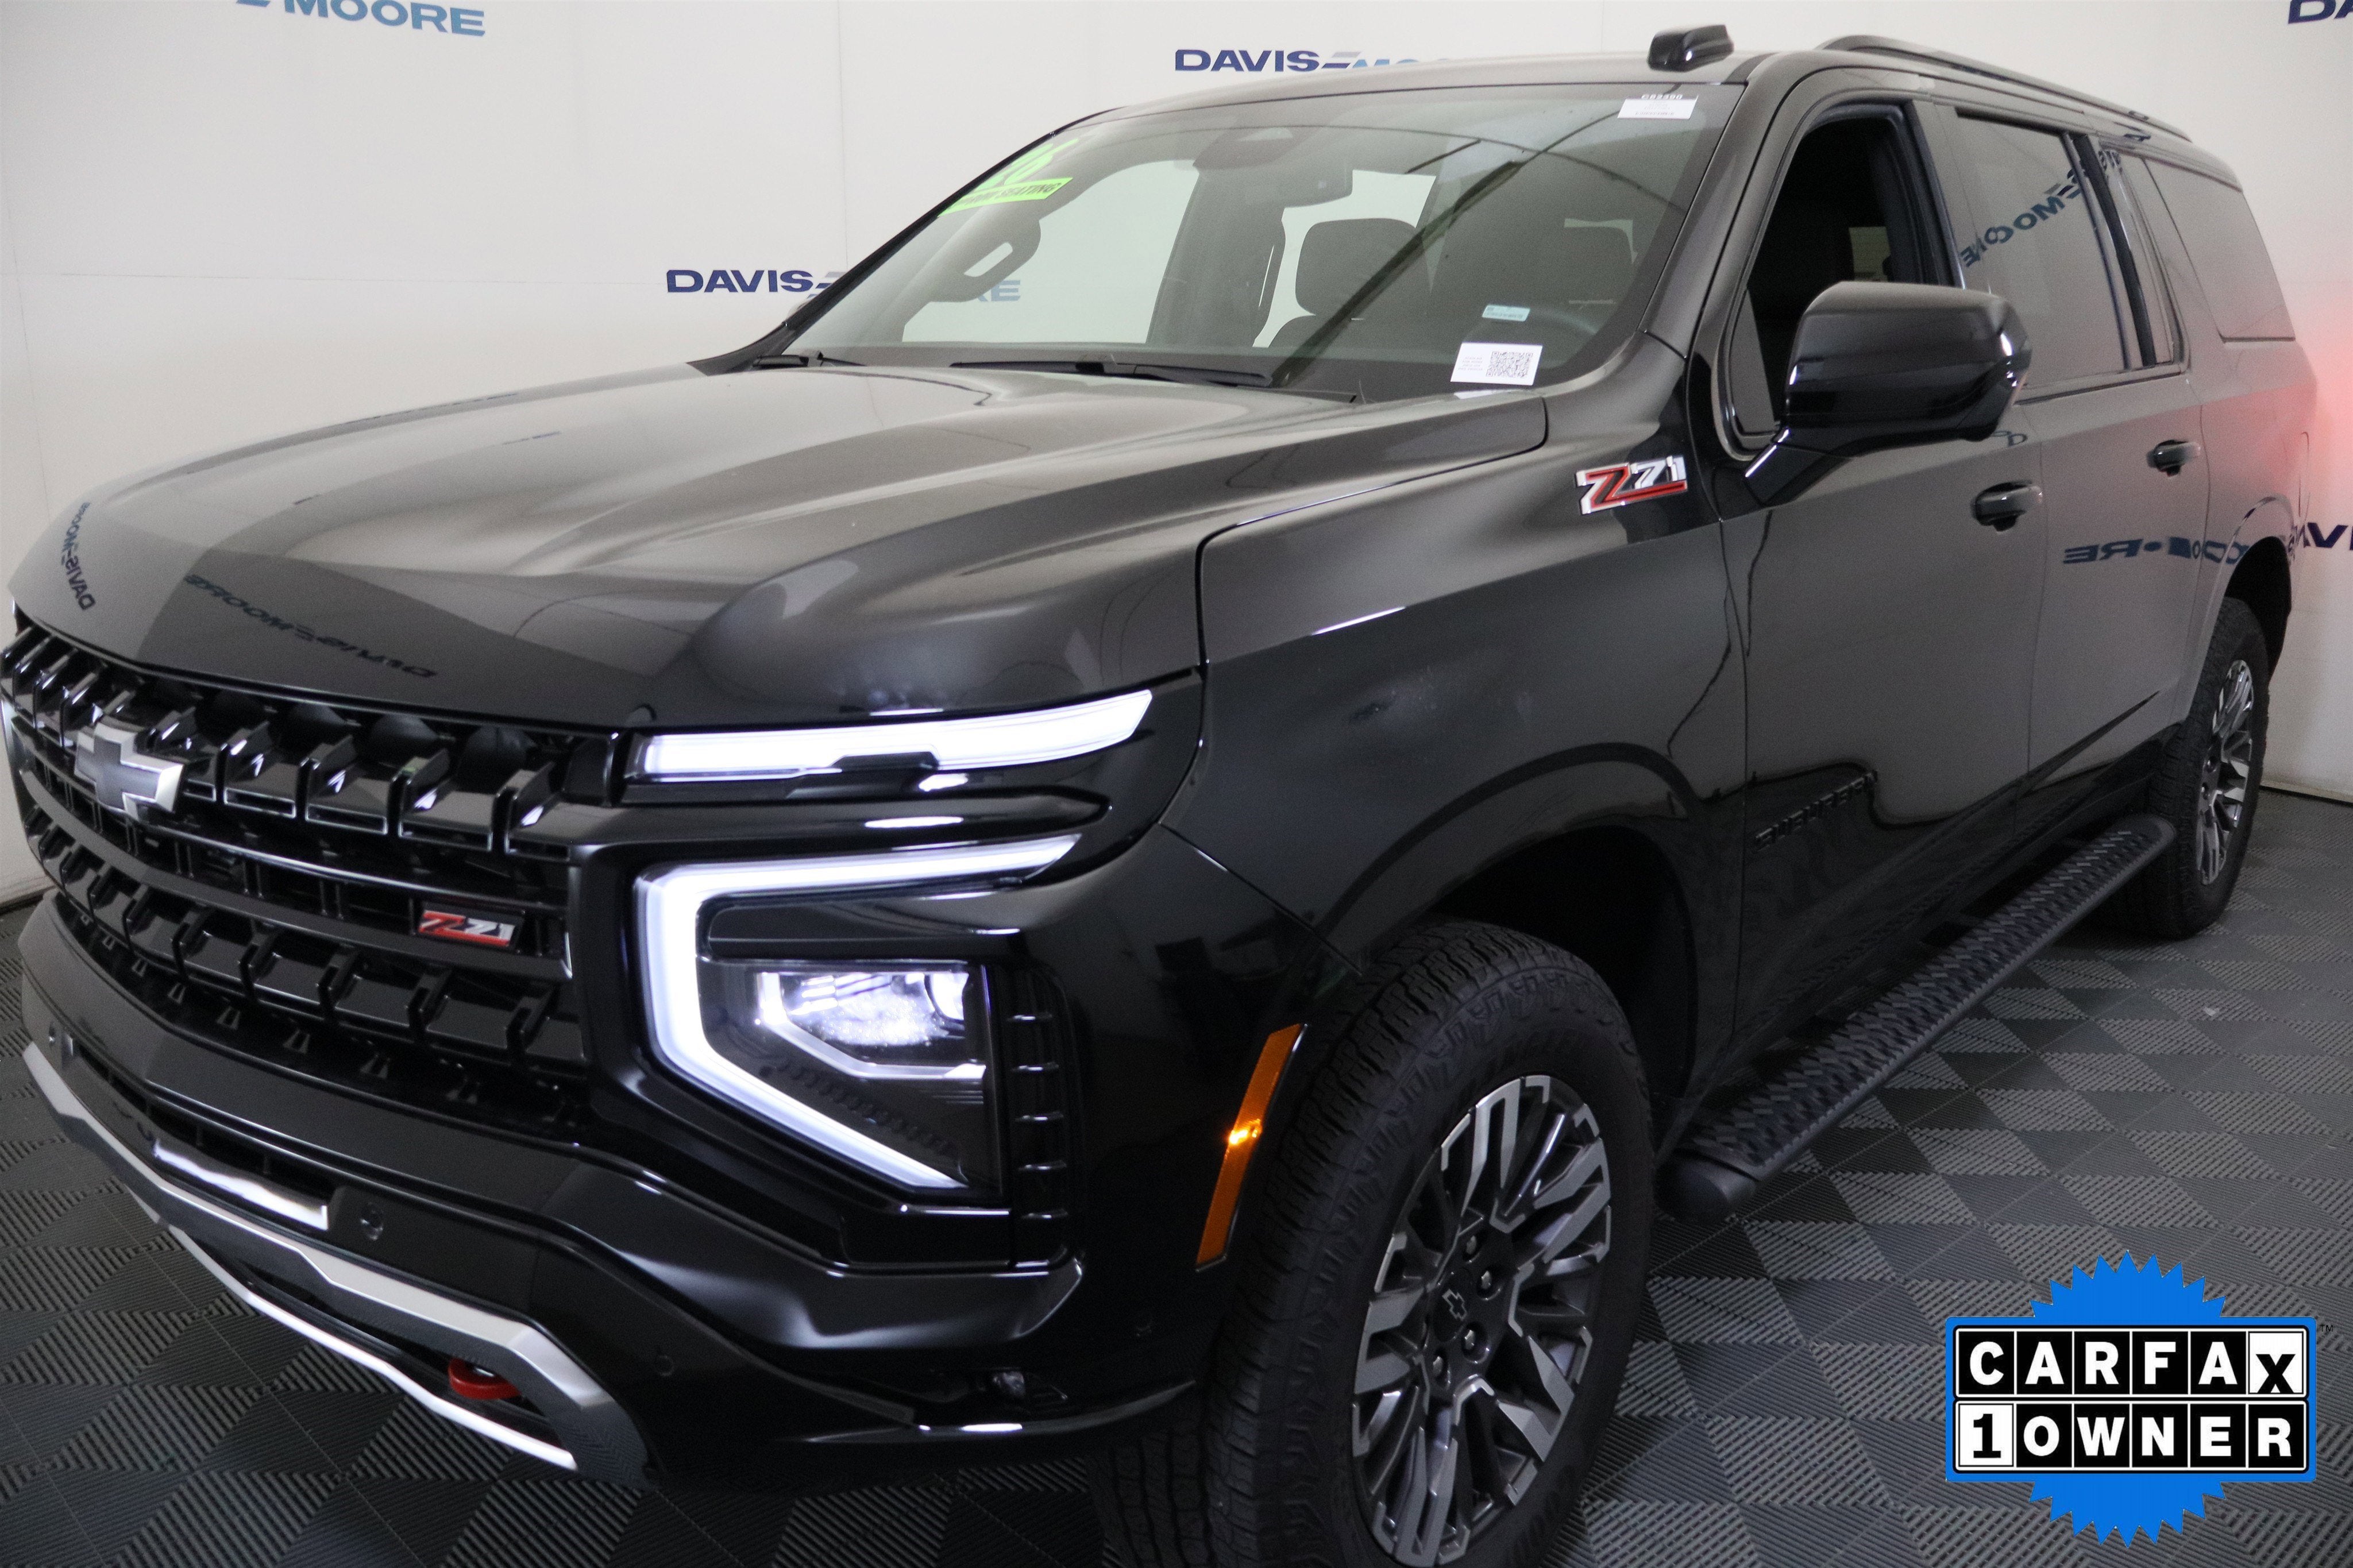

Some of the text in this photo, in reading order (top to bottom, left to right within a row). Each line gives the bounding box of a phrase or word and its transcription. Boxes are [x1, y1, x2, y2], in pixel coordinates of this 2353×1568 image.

[1175, 49, 1320, 72] DAVIS
[666, 269, 813, 293] DAVIS
[1575, 455, 1688, 515] Z71
[418, 910, 515, 947] Z71
